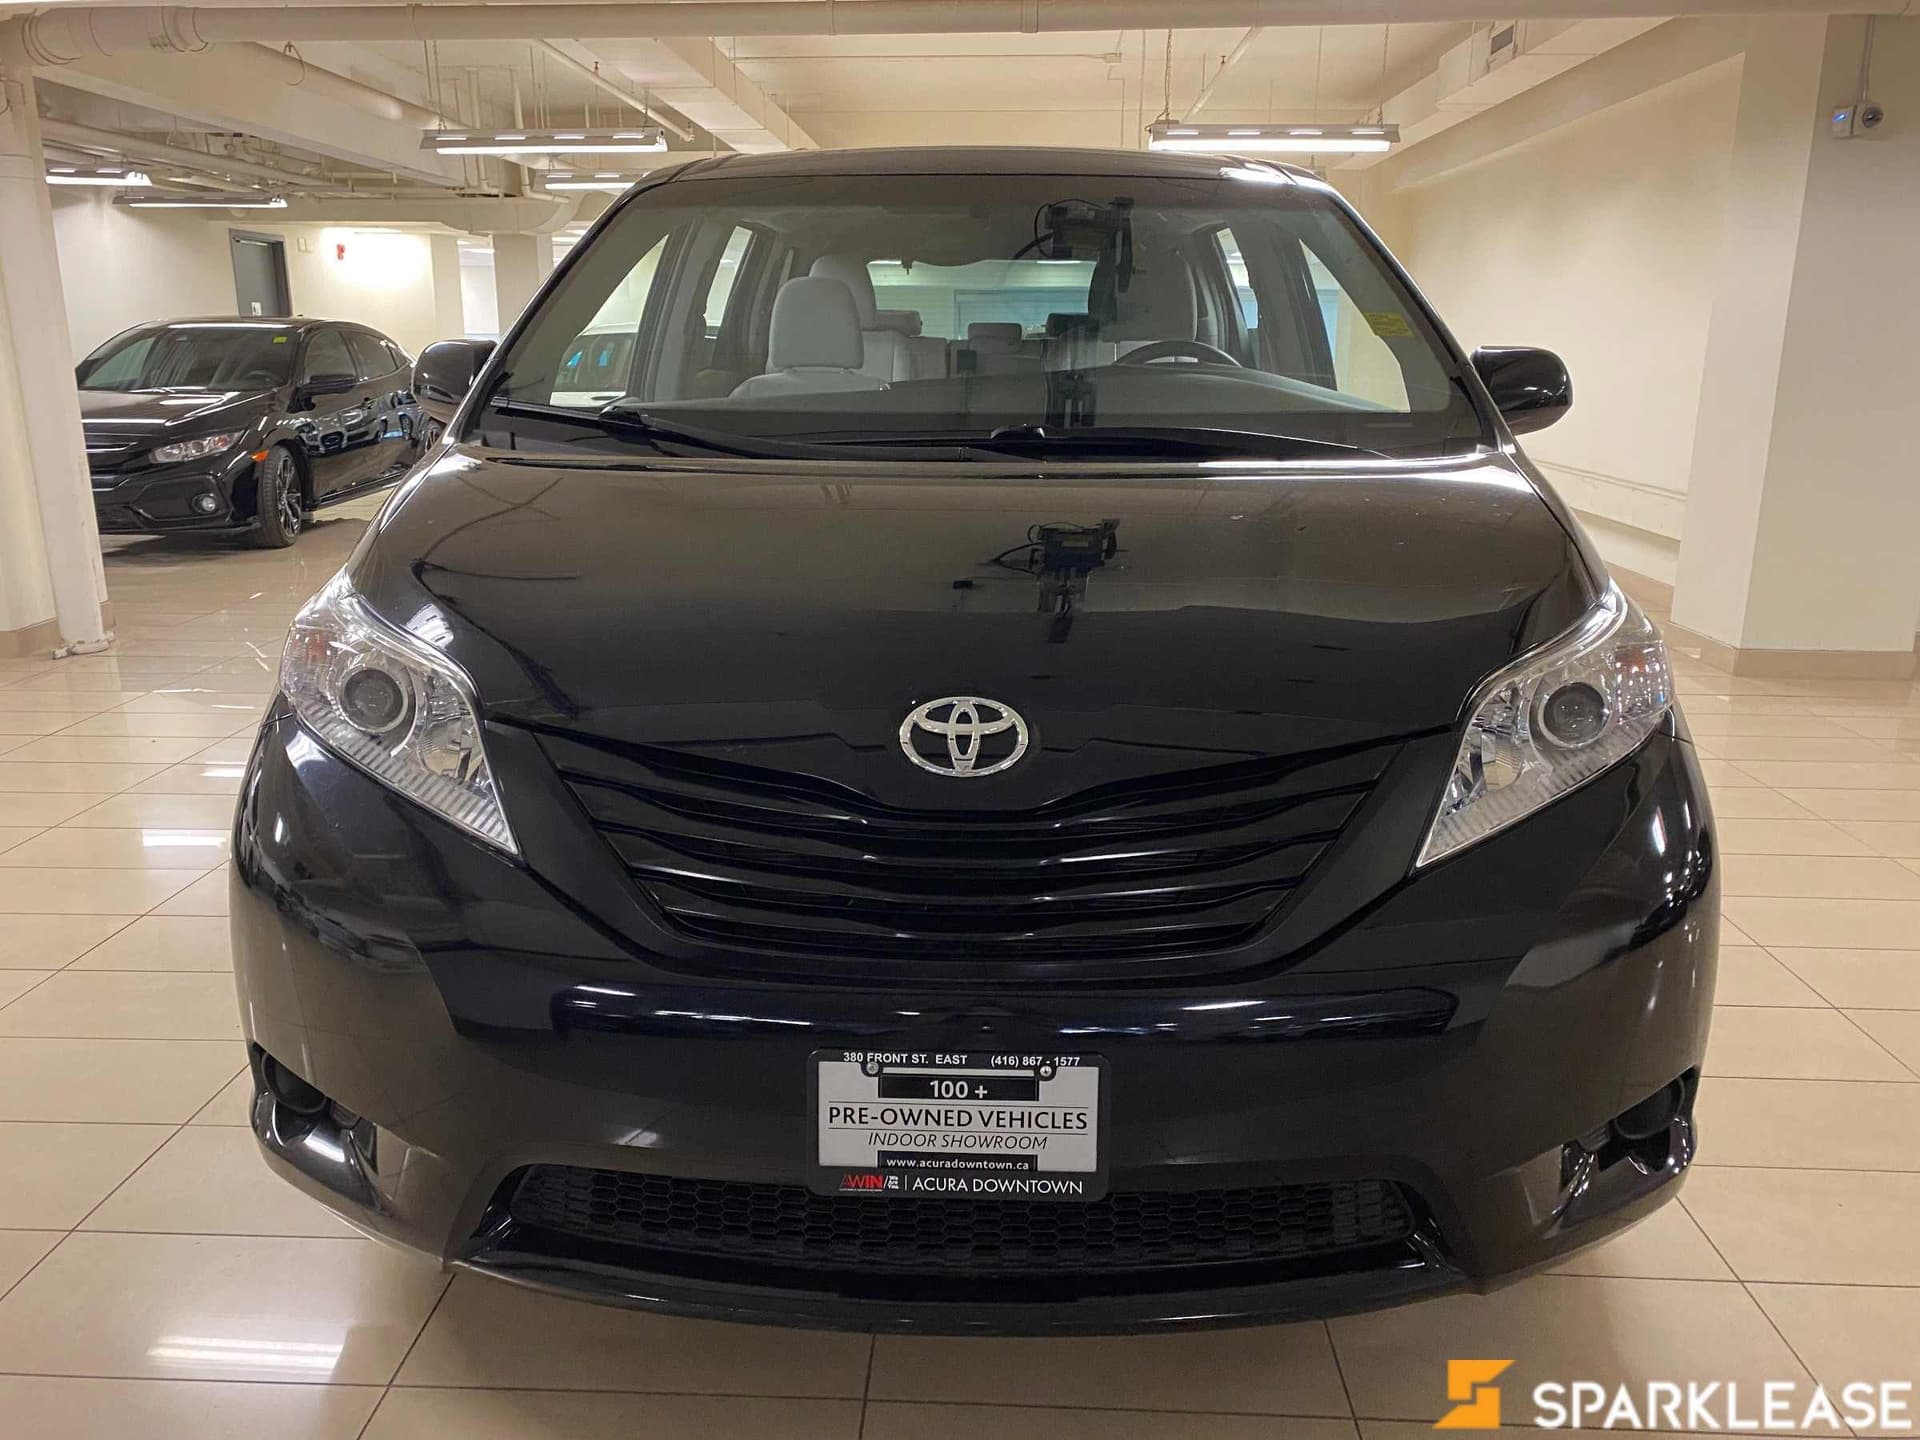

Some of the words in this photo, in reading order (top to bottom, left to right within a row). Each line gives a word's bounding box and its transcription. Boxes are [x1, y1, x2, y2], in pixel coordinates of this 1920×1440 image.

[843, 1052, 863, 1062] 380
[867, 1053, 908, 1063] FRONT
[911, 1054, 929, 1064] ST.
[935, 1054, 967, 1065] EAST
[991, 1056, 1019, 1068] (416)
[1022, 1056, 1042, 1066] 867
[1054, 1056, 1080, 1066] 1577
[929, 1080, 969, 1099] 100
[974, 1085, 988, 1099] +
[829, 1107, 973, 1127] PRE-OWNED
[978, 1110, 1087, 1130] VEHICLES
[868, 1132, 937, 1147] INDOOR
[941, 1134, 1048, 1150] SHOWROOM
[886, 1158, 1029, 1170] www.acuradowntown.ca
[912, 1177, 968, 1192] ACURA
[973, 1179, 1083, 1194] DOWNTOWN
